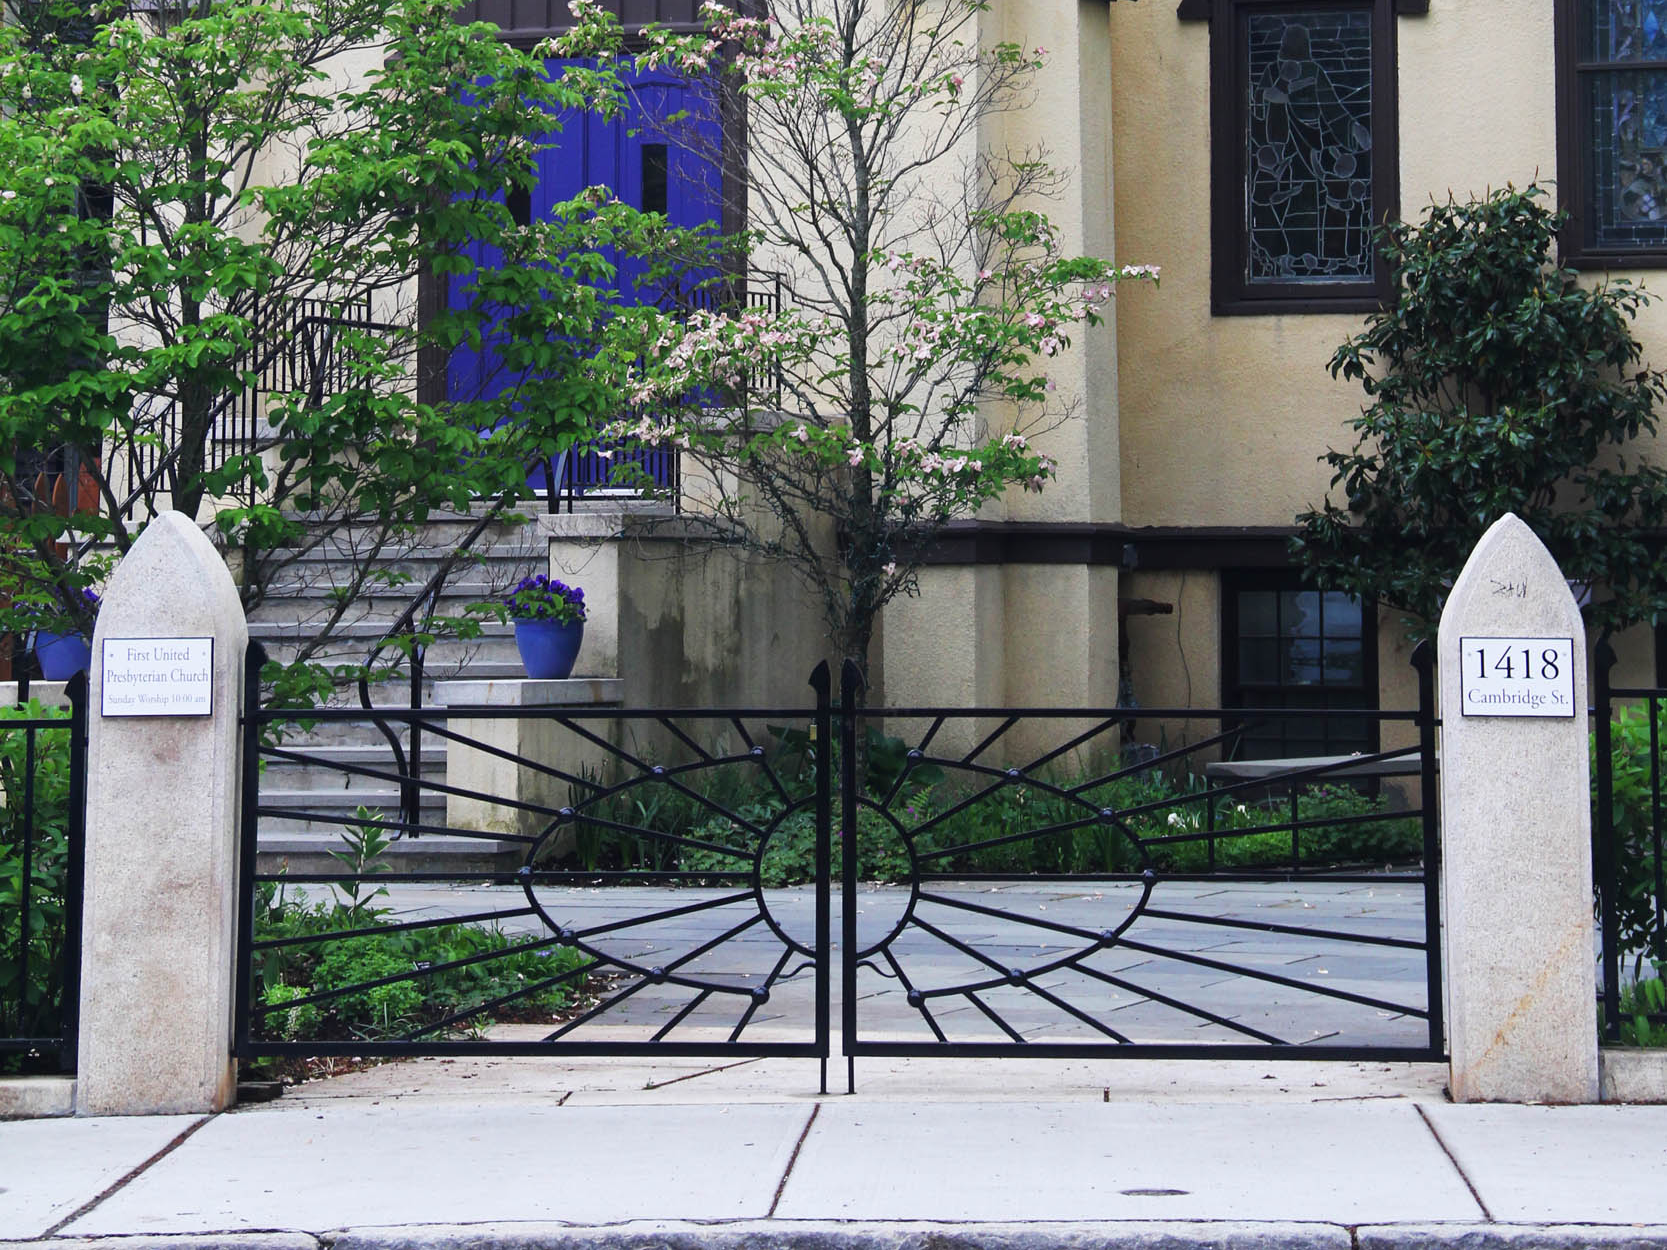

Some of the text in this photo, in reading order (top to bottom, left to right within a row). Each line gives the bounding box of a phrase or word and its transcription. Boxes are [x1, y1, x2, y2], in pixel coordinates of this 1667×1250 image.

[127, 647, 189, 661] First United
[1476, 646, 1559, 679] 1418
[107, 668, 208, 686] Presbyterian Church
[138, 694, 169, 707] Worship
[1468, 688, 1568, 709] Cambridge St.
